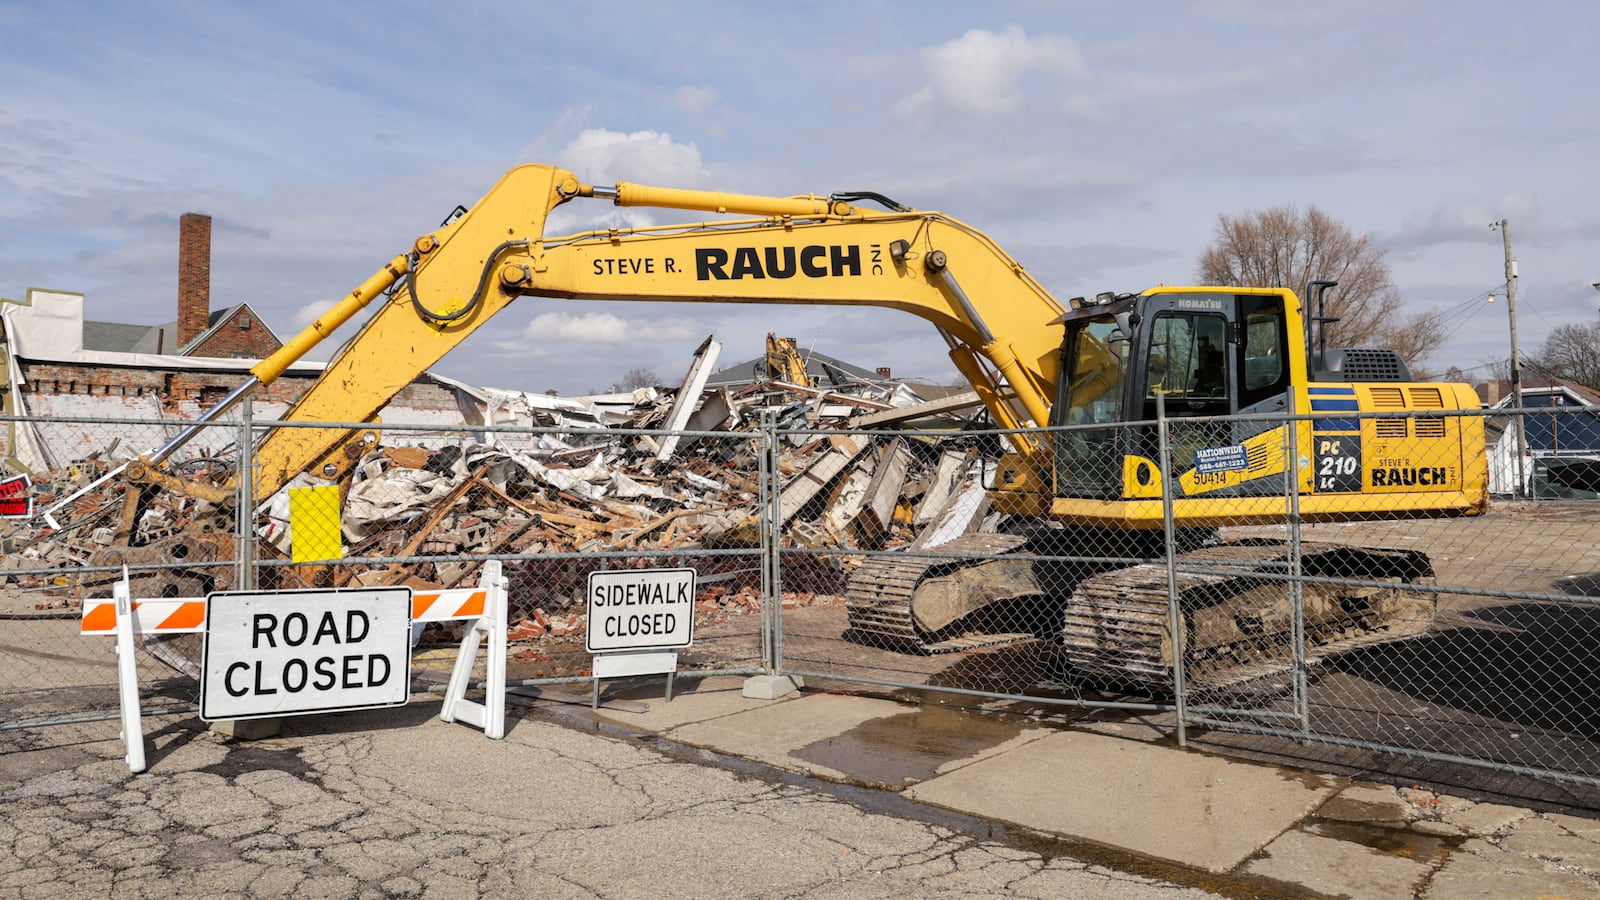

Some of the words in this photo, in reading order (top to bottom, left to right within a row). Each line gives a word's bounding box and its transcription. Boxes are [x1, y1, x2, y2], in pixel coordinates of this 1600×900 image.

[593, 258, 655, 275] STEVE
[664, 258, 683, 273] R.
[695, 245, 862, 281] RAUCH
[870, 244, 883, 276] INC
[1178, 299, 1222, 309] KOMATSU
[1197, 446, 1243, 458] NATIONWIDE
[1319, 440, 1341, 455] PC
[1320, 456, 1357, 475] 210
[1379, 458, 1402, 467] STEVE
[1320, 476, 1336, 489] LC
[1372, 467, 1446, 486] RAUCH
[594, 582, 688, 607] SIDEWALK
[252, 610, 370, 648] ROAD
[605, 613, 676, 637] CLOSED
[224, 654, 391, 697] CLOSED
